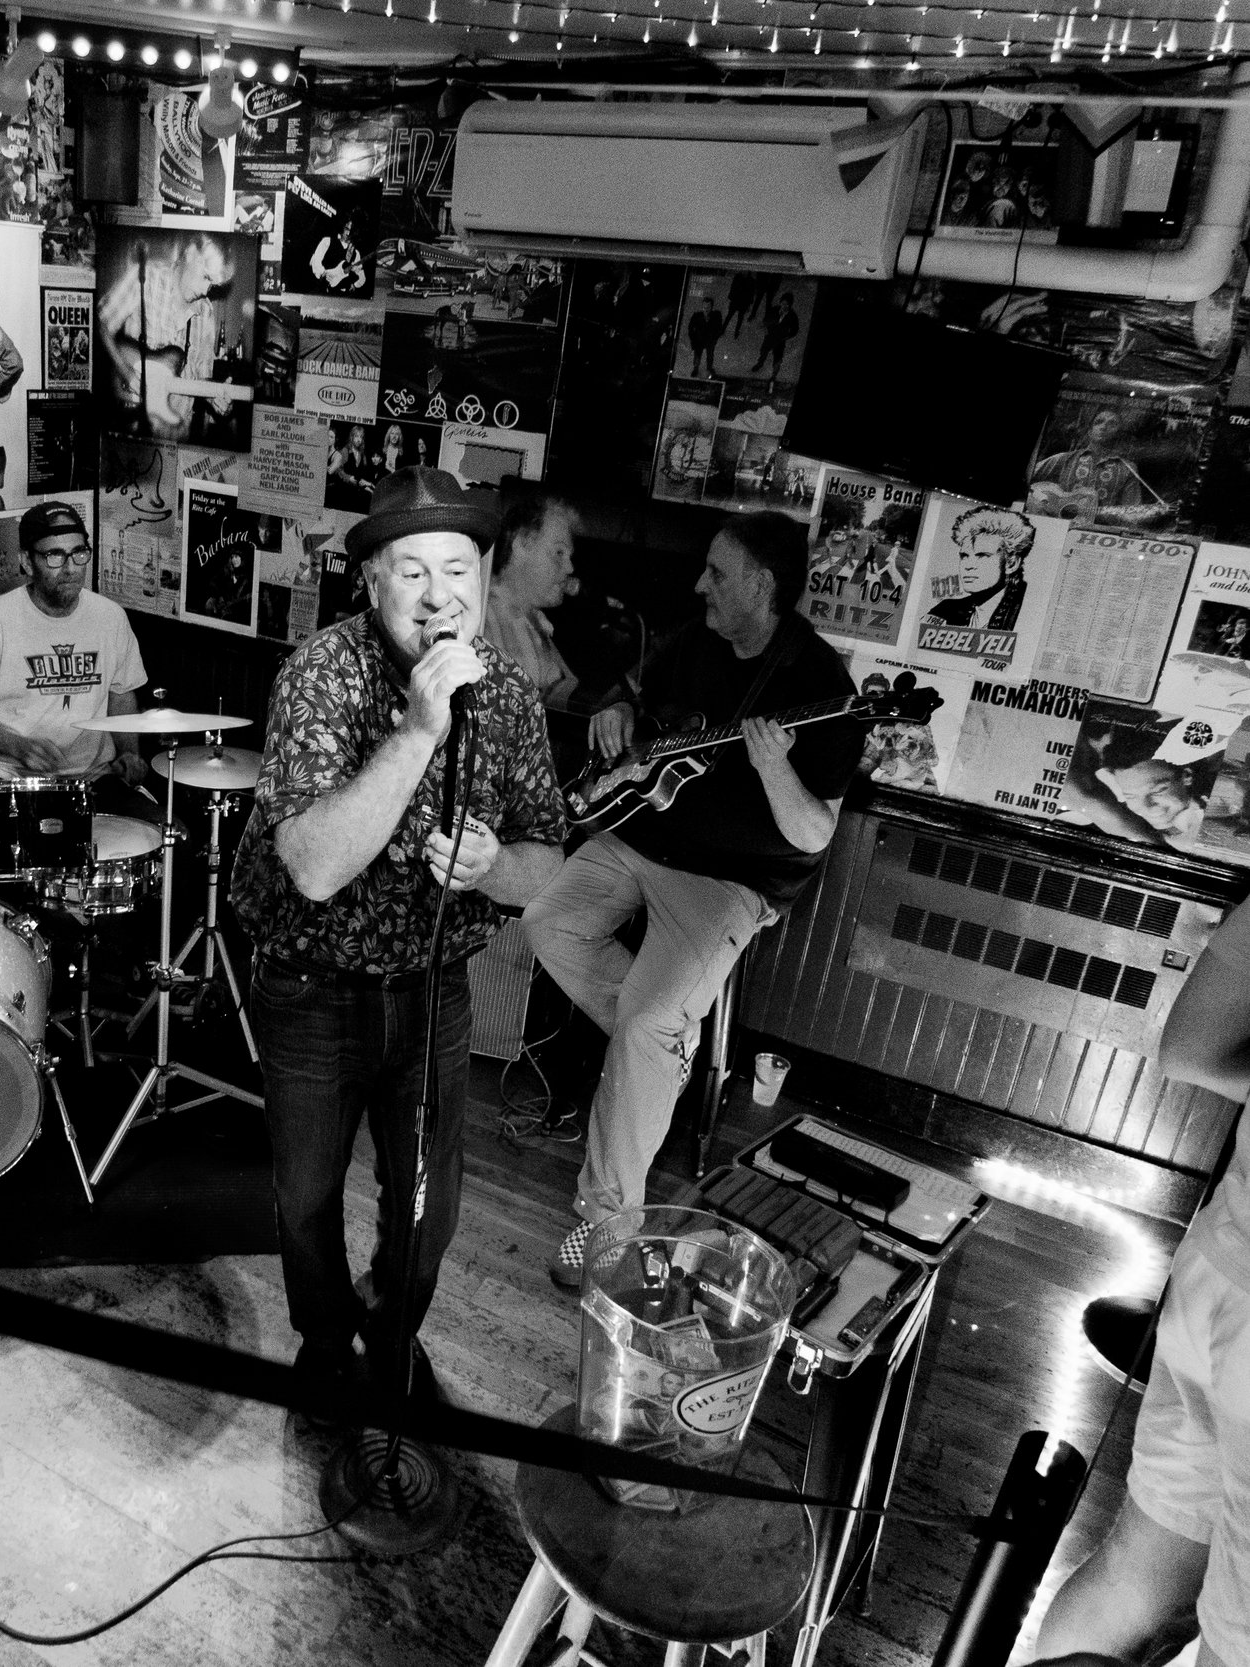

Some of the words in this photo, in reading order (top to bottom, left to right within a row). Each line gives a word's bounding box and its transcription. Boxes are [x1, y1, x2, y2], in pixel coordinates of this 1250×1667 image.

[48, 305, 91, 326] QUEEN
[323, 361, 354, 378] DANCE
[355, 365, 381, 381] BAND
[321, 389, 333, 399] THE
[264, 414, 280, 422] BOB
[280, 417, 305, 426] JAMES
[276, 423, 292, 432] AND
[261, 429, 280, 438] EARL
[280, 432, 306, 442] KLUGH
[443, 423, 489, 440] Genesis
[253, 455, 282, 467] HARVEY
[283, 460, 310, 471] MASON
[259, 448, 274, 457] RON
[275, 451, 305, 461] CARTER
[247, 462, 271, 472] RALPH
[271, 466, 314, 480] MacDONALD
[260, 473, 282, 482] GARY
[282, 475, 300, 486] KING
[259, 480, 276, 490] NEIL
[276, 483, 300, 494] JASON
[827, 476, 877, 499] House
[883, 483, 926, 507] Band
[192, 492, 210, 505] Friday
[216, 497, 226, 507] the
[194, 516, 250, 568] Barbara
[1076, 533, 1134, 551] HOT
[1138, 540, 1182, 557] 100
[325, 552, 347, 575] Tina
[1204, 564, 1250, 581] JOHN
[809, 571, 848, 597] SAT
[860, 579, 903, 606] 10-4
[1209, 581, 1235, 591] and
[809, 599, 893, 629] RITZ
[919, 627, 975, 652] REBEL
[976, 633, 1017, 657] YELL
[31, 653, 95, 678] BLUES
[875, 657, 902, 669] CAPTAIN
[980, 658, 1007, 672] TOUR
[970, 680, 1087, 722] MCMAHON
[1045, 740, 1074, 757] LIVE
[1055, 757, 1070, 771] @
[1042, 768, 1066, 785] THE
[1032, 782, 1062, 800] RITZ
[994, 790, 1015, 805] FRI
[1015, 795, 1040, 811] JAN
[1041, 800, 1057, 814] 19
[685, 1392, 719, 1413] THE
